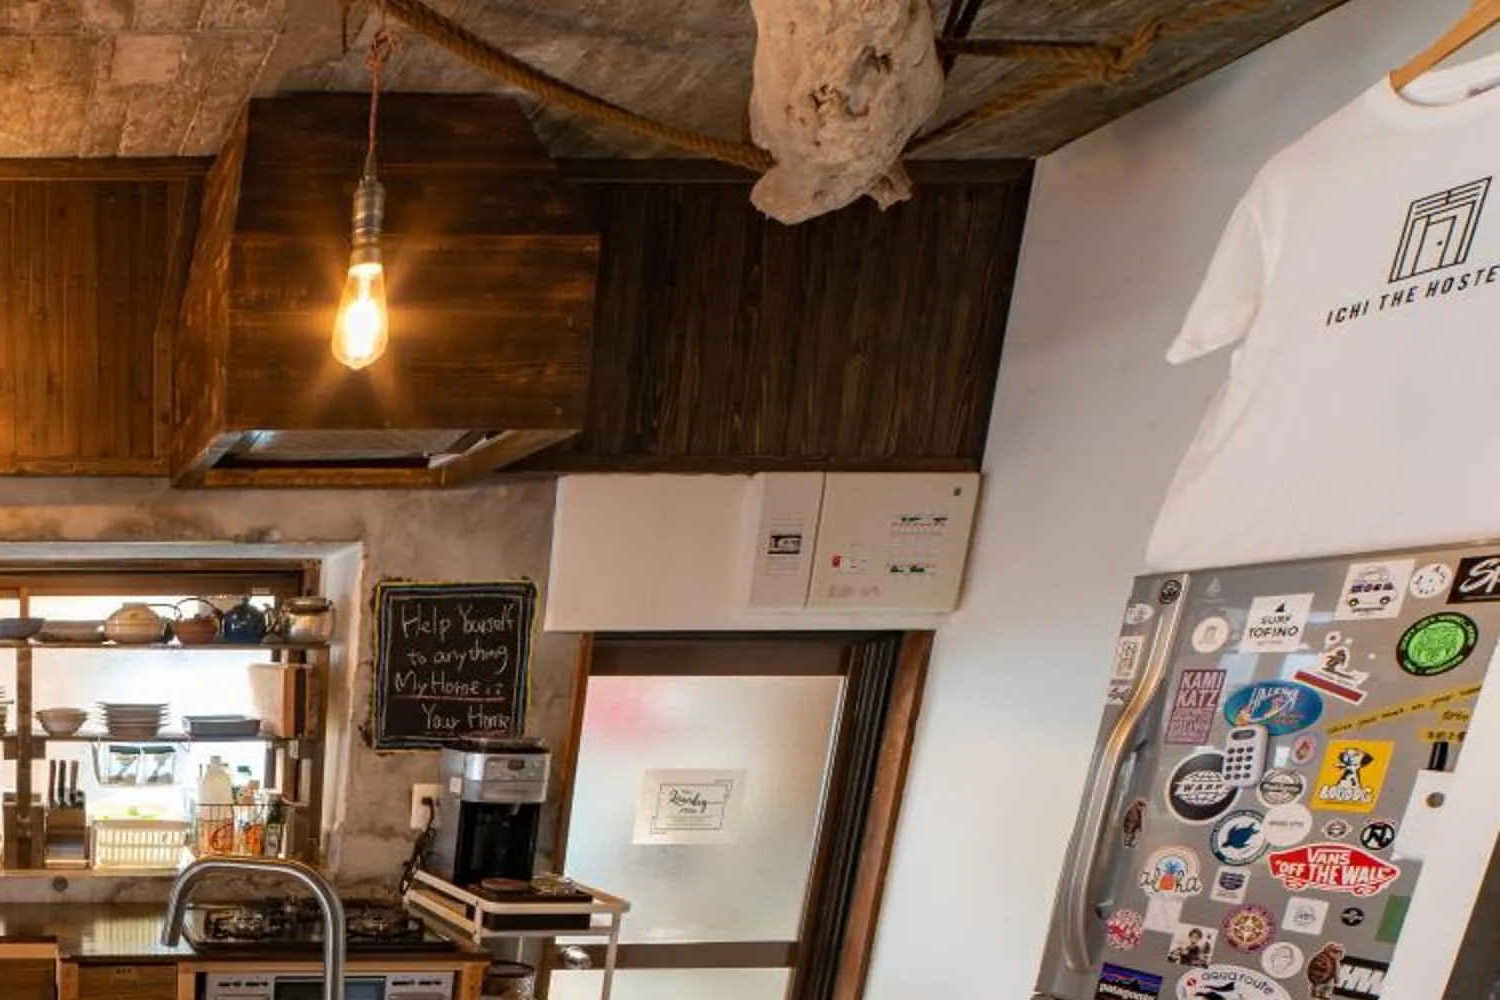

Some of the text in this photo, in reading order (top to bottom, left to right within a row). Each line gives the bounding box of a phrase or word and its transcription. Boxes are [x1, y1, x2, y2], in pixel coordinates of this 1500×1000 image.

[1326, 300, 1369, 326] ICHI
[1379, 285, 1417, 311] THE
[402, 602, 451, 642] Help
[1249, 625, 1299, 639] TOFINO
[407, 639, 509, 675] to anything
[395, 669, 428, 697] My
[1181, 671, 1225, 690] KAMI
[1176, 690, 1219, 708] KATZ
[421, 703, 460, 730] Your
[1307, 848, 1352, 865] VANS
[1310, 863, 1343, 885] THE
[1201, 971, 1275, 995] aqua route
